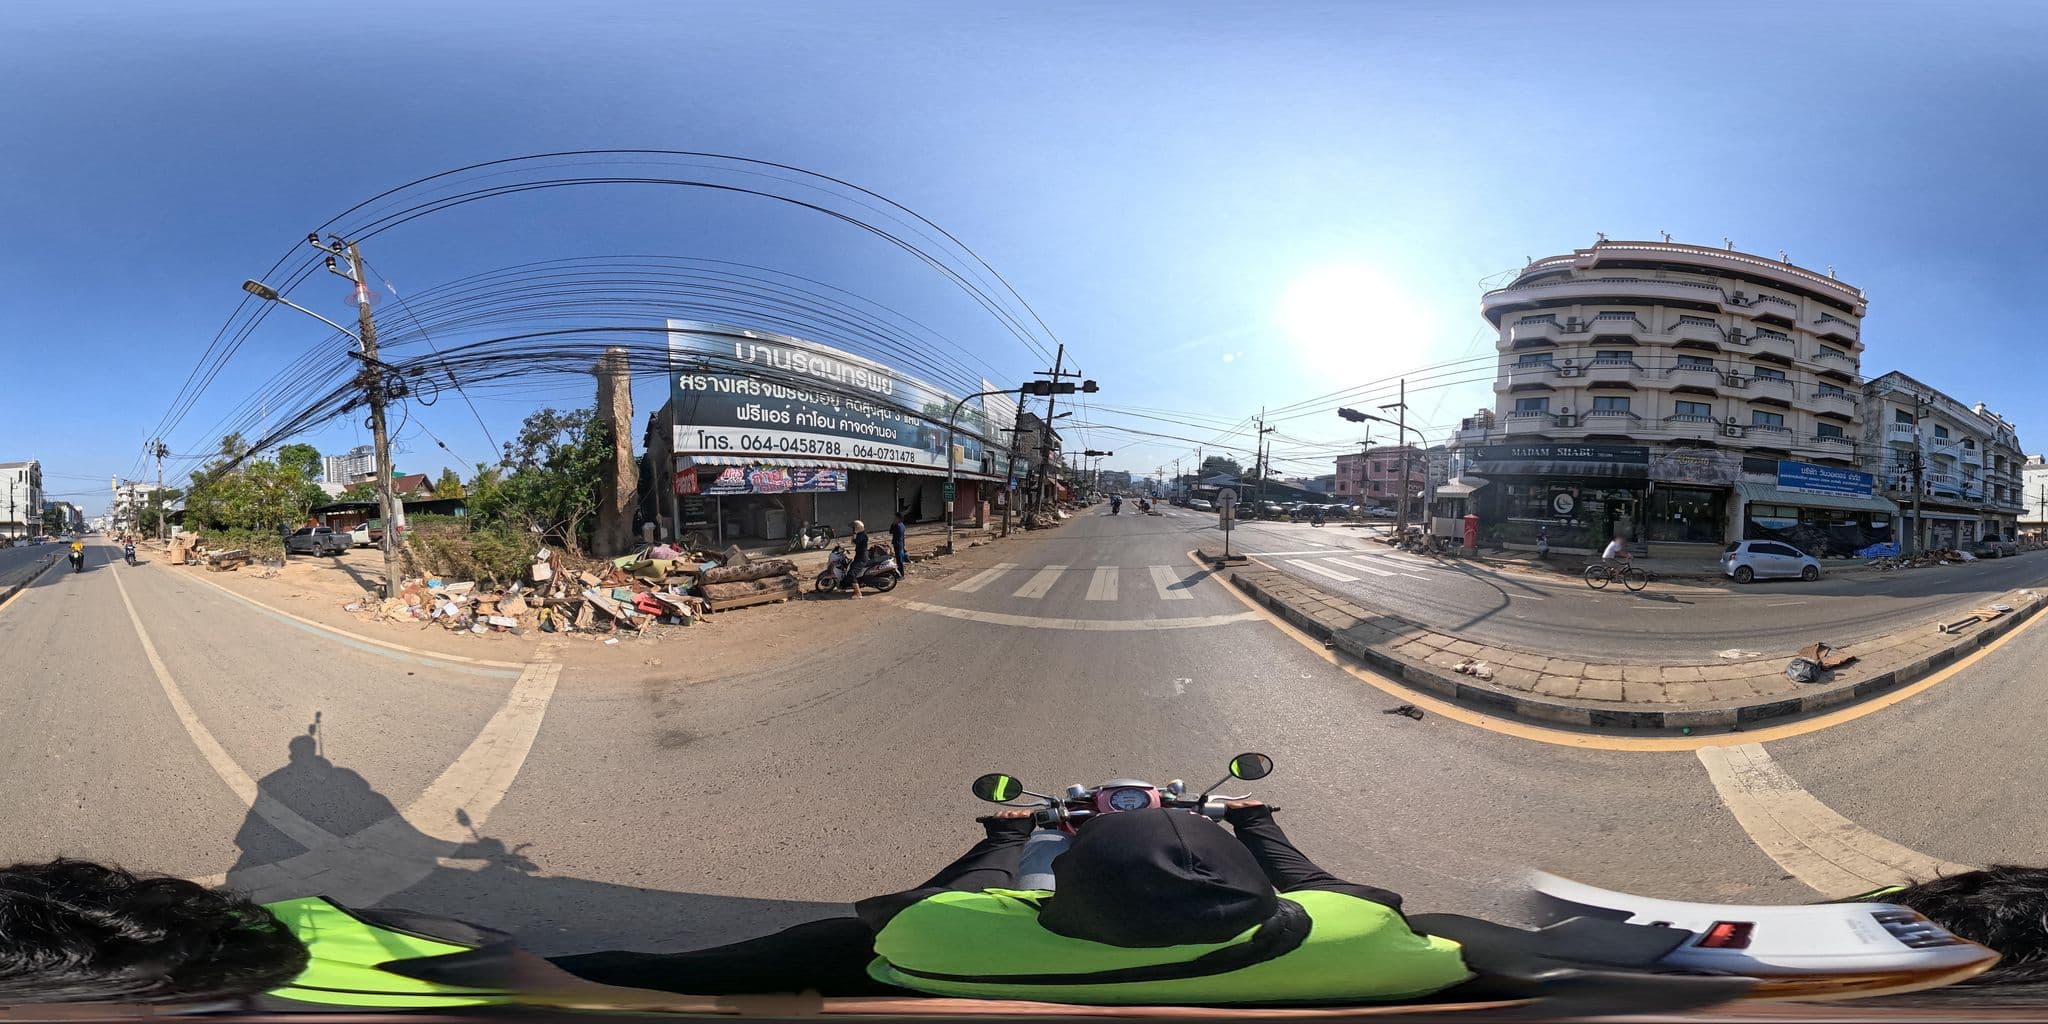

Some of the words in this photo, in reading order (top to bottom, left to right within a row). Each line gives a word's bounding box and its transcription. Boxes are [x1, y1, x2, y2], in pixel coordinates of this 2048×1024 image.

[736, 402, 791, 424] ฟรีแอร์
[796, 405, 836, 430] ค่าโอน
[839, 413, 897, 440] ค่าจดจำนอง
[697, 430, 734, 450] โทร.
[741, 434, 841, 456] 064-0458788
[853, 444, 915, 463] 064-0731478
[1511, 448, 1550, 457] MADAM
[1556, 447, 1595, 457] SHABU
